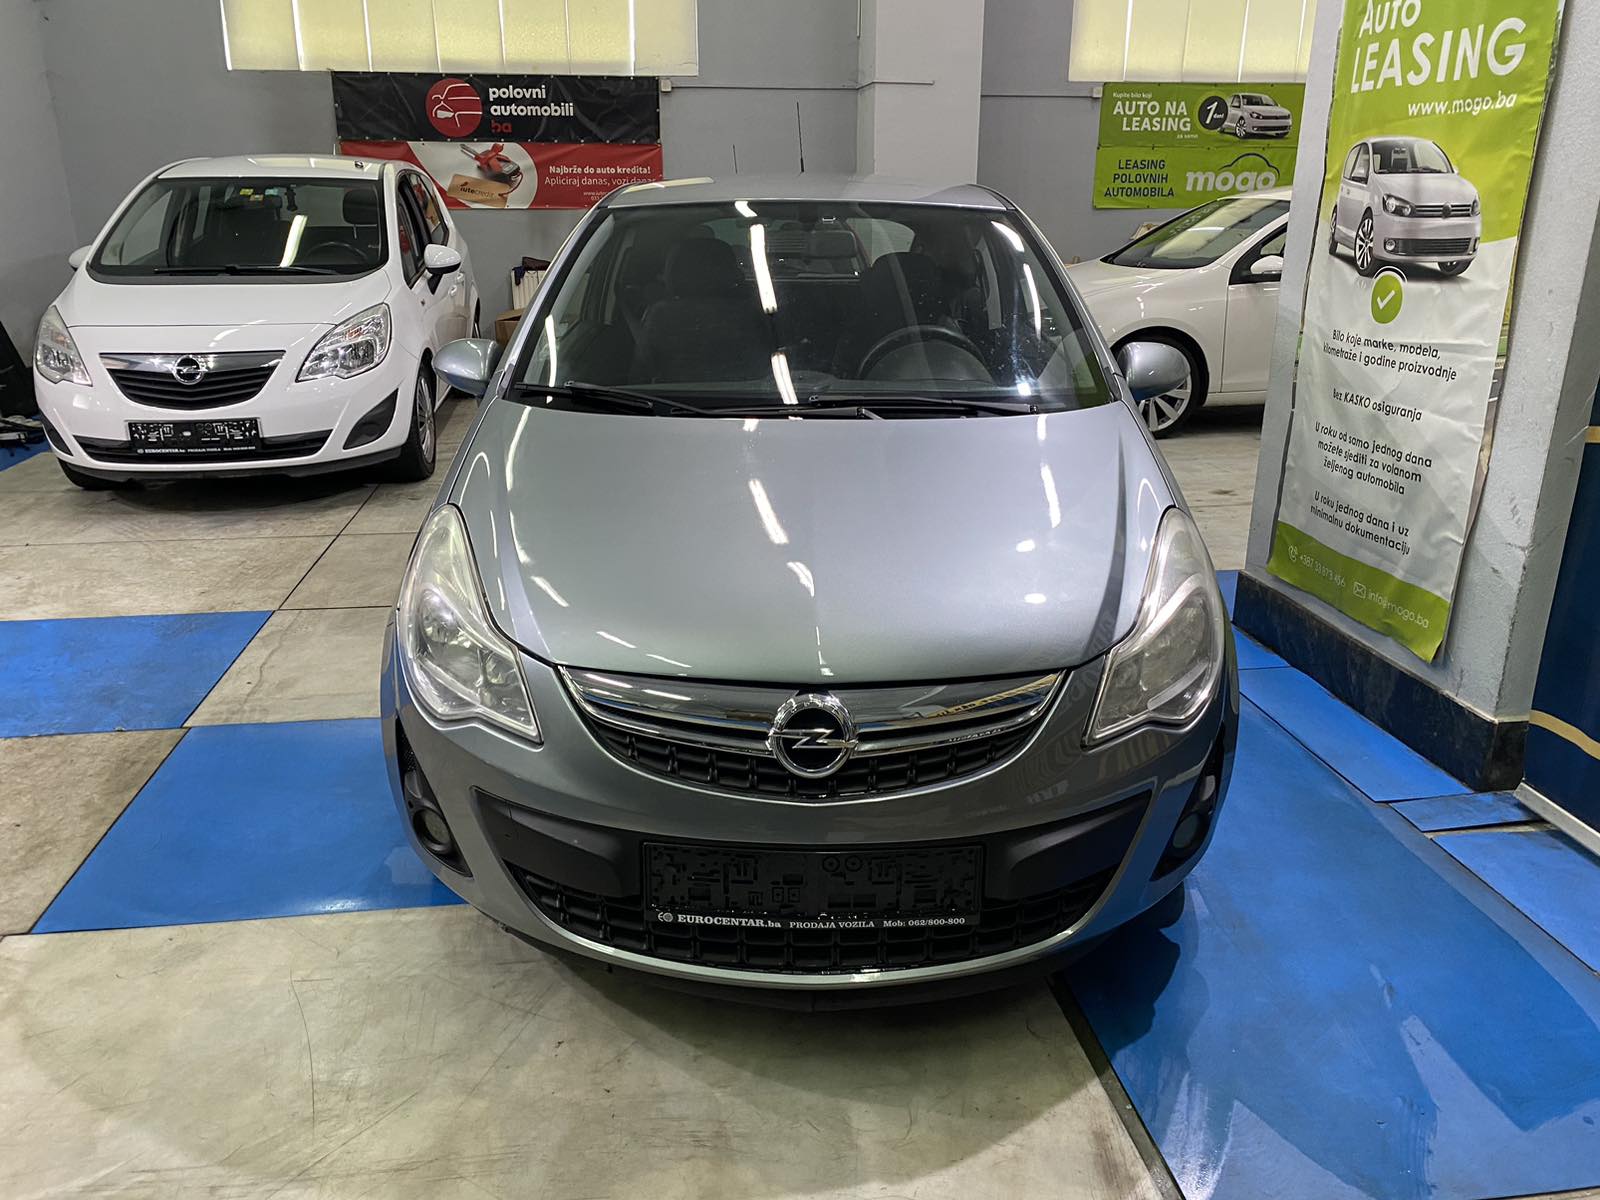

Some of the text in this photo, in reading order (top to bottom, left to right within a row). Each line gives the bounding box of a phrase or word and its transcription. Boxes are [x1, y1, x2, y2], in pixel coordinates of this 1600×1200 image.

[1350, 17, 1526, 94] LEASING
[489, 85, 546, 101] polovni
[1408, 90, 1517, 115] www.mogo.ba
[490, 103, 574, 116] automobili
[1113, 101, 1188, 115] AUTO NA
[1206, 101, 1218, 124] 1
[1122, 117, 1191, 131] LEASING
[549, 165, 651, 174] Najbrže do auto kredita!
[1118, 159, 1165, 170] LEASING
[545, 177, 579, 187] Apliciraj
[581, 177, 610, 186] danas,
[1113, 173, 1168, 184] POLOVNIH
[1104, 187, 1174, 197] AUTOMOBILA
[1332, 330, 1441, 359] Bilo koje marke, modela,
[1359, 351, 1362, 362] i
[1364, 354, 1396, 368] godine
[1398, 360, 1457, 382] proizvodnje
[1343, 391, 1371, 408] KASKO
[1371, 401, 1422, 422] osiguranja
[1315, 421, 1432, 468] U roku od samo jednog dana
[1318, 440, 1421, 482] možete sjediti za volanom
[1323, 456, 1405, 495] željenog automobila
[1315, 490, 1410, 537] U roku jednog dana i uz
[1310, 504, 1410, 555] minimalnu dokumentaciju
[677, 914, 782, 928] EUROCENTAR.ba
[789, 921, 836, 929] PRODAJA
[883, 919, 906, 928] Mob:
[908, 917, 966, 926] 062/800-800
